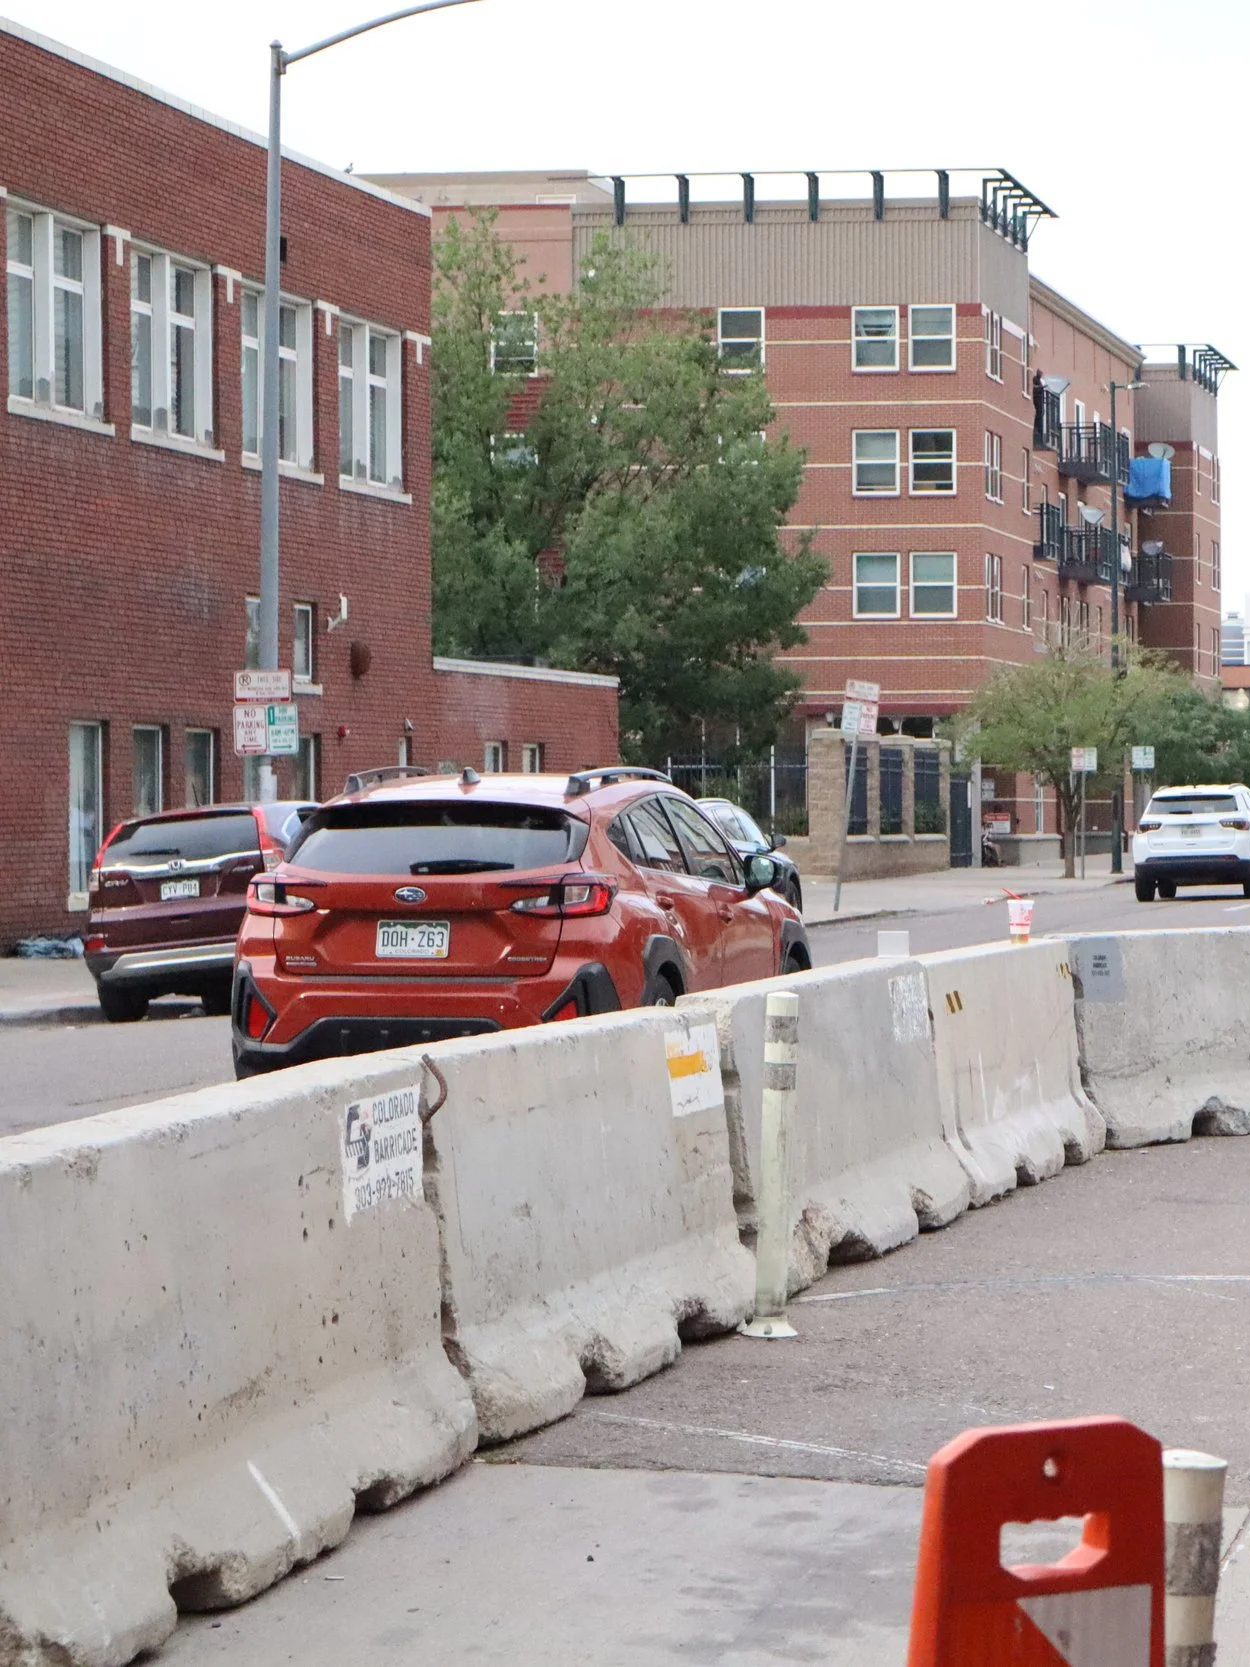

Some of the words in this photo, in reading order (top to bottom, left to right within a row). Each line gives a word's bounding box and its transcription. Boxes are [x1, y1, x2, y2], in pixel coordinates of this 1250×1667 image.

[244, 709, 256, 718] NO
[236, 720, 265, 729] PARKING
[372, 1092, 414, 1125] COLORADO
[373, 1128, 418, 1164] BARRICADE
